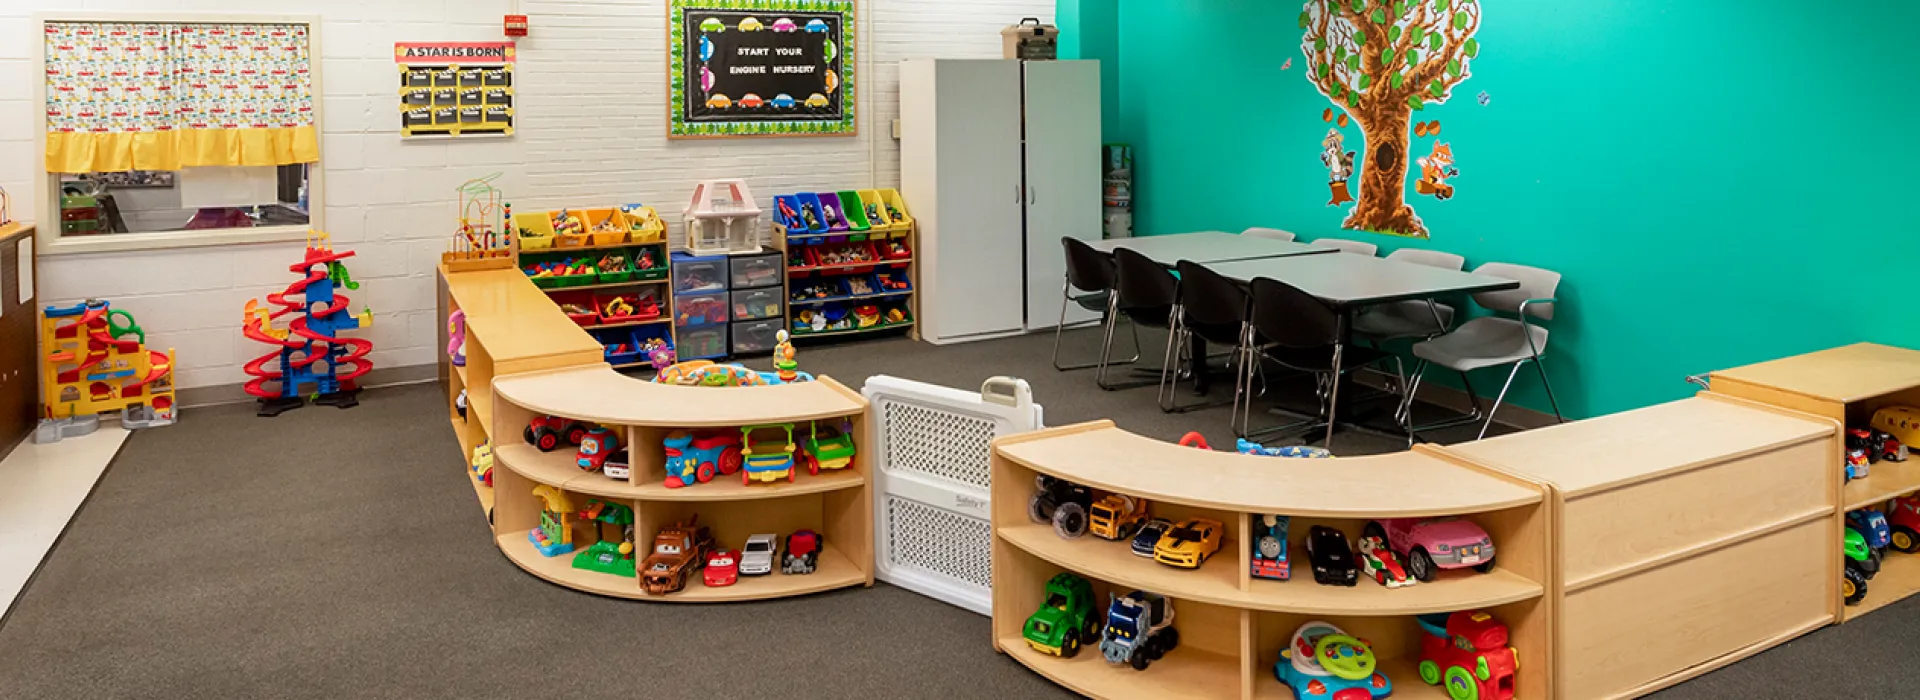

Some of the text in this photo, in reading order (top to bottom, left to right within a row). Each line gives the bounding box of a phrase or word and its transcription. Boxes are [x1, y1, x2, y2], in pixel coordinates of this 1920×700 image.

[406, 47, 500, 57] A STAR IS BORN
[737, 47, 802, 56] START YOUR
[729, 65, 815, 74] ENGINE NURSERY
